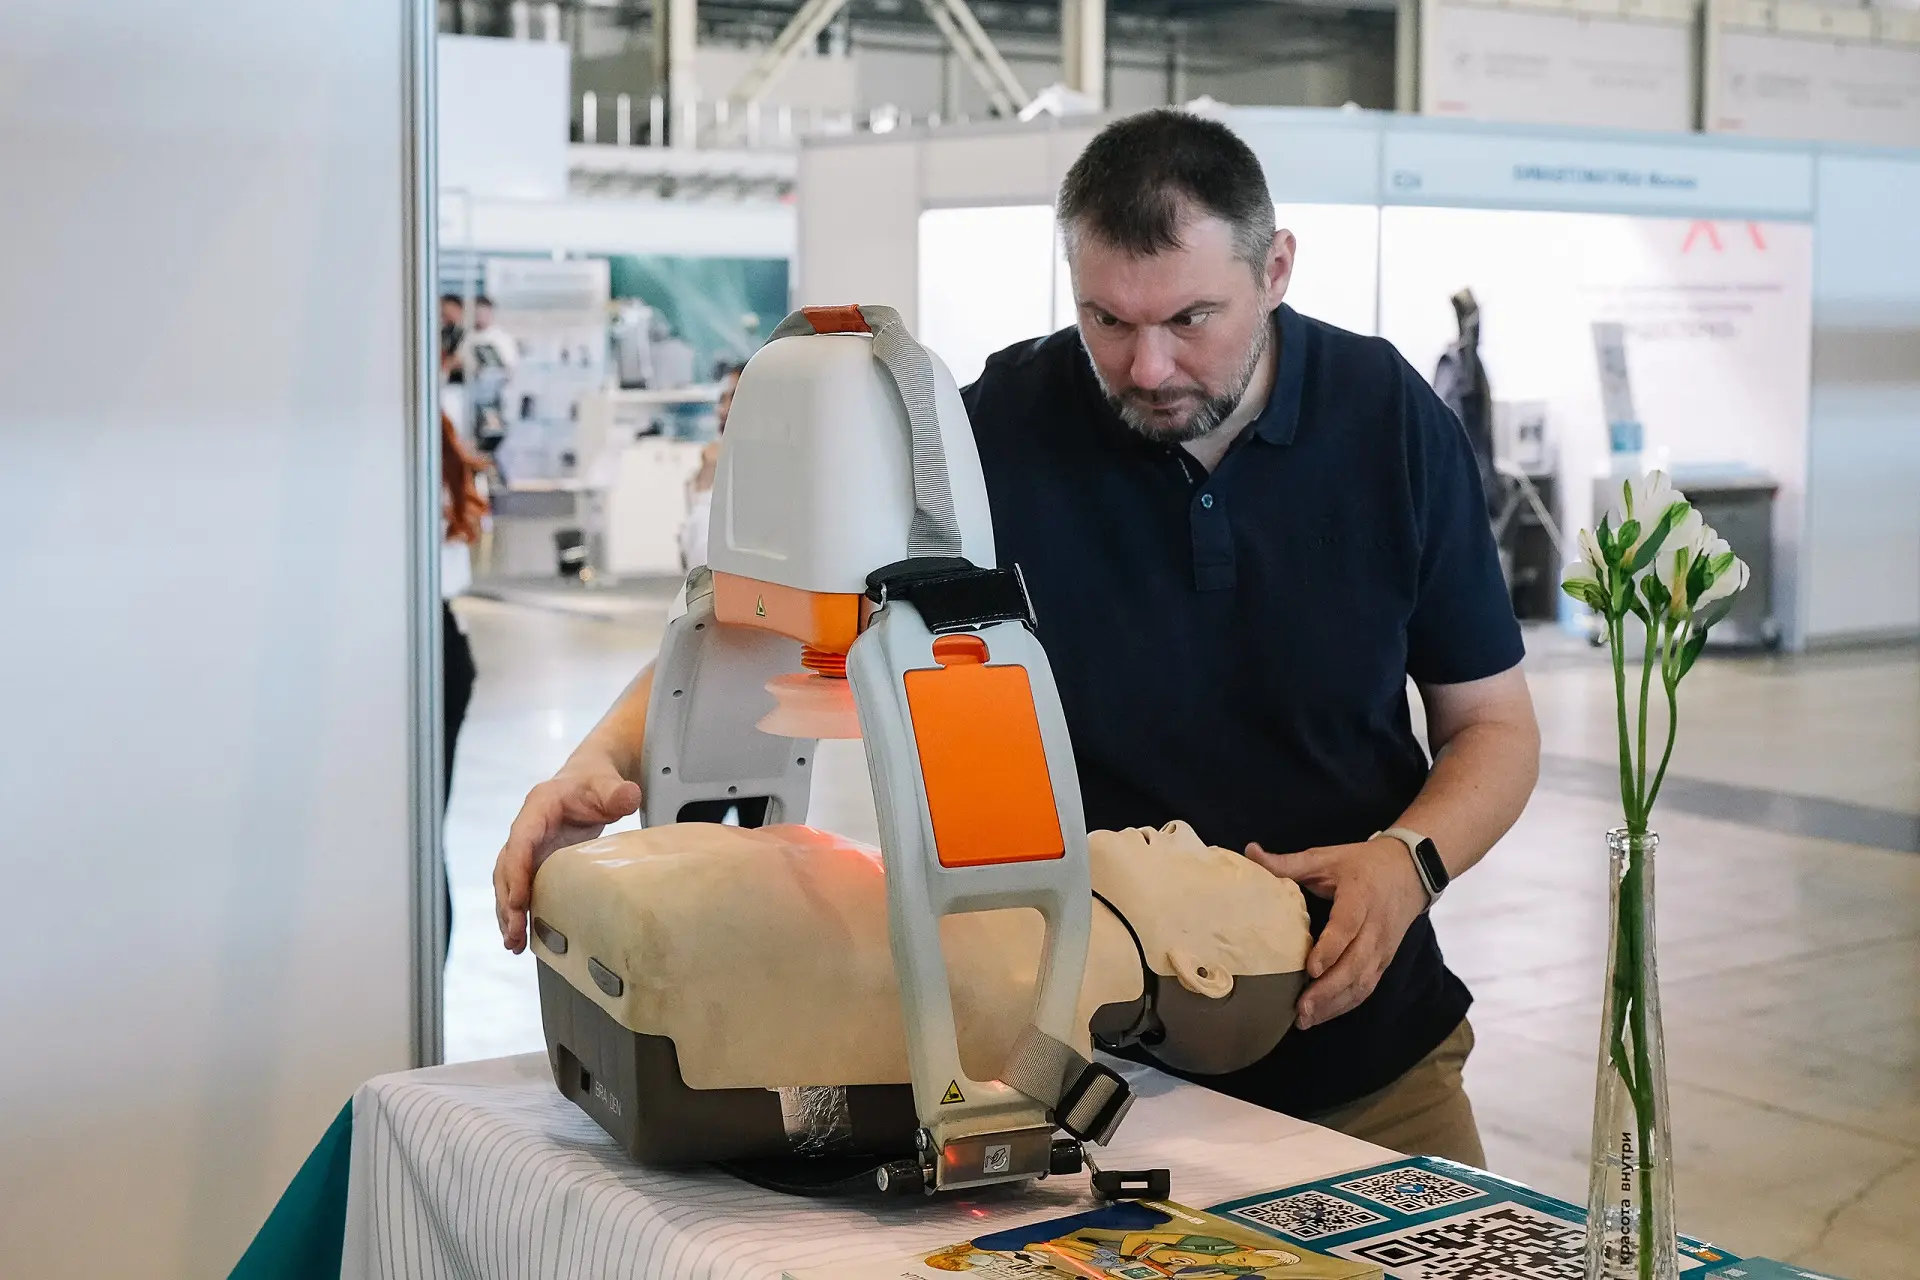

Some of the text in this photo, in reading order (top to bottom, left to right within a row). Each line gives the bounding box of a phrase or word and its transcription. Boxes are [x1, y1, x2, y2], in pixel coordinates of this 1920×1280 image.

[595, 1081, 621, 1117] BRADEN
[1620, 1132, 1634, 1265] красота внутри
